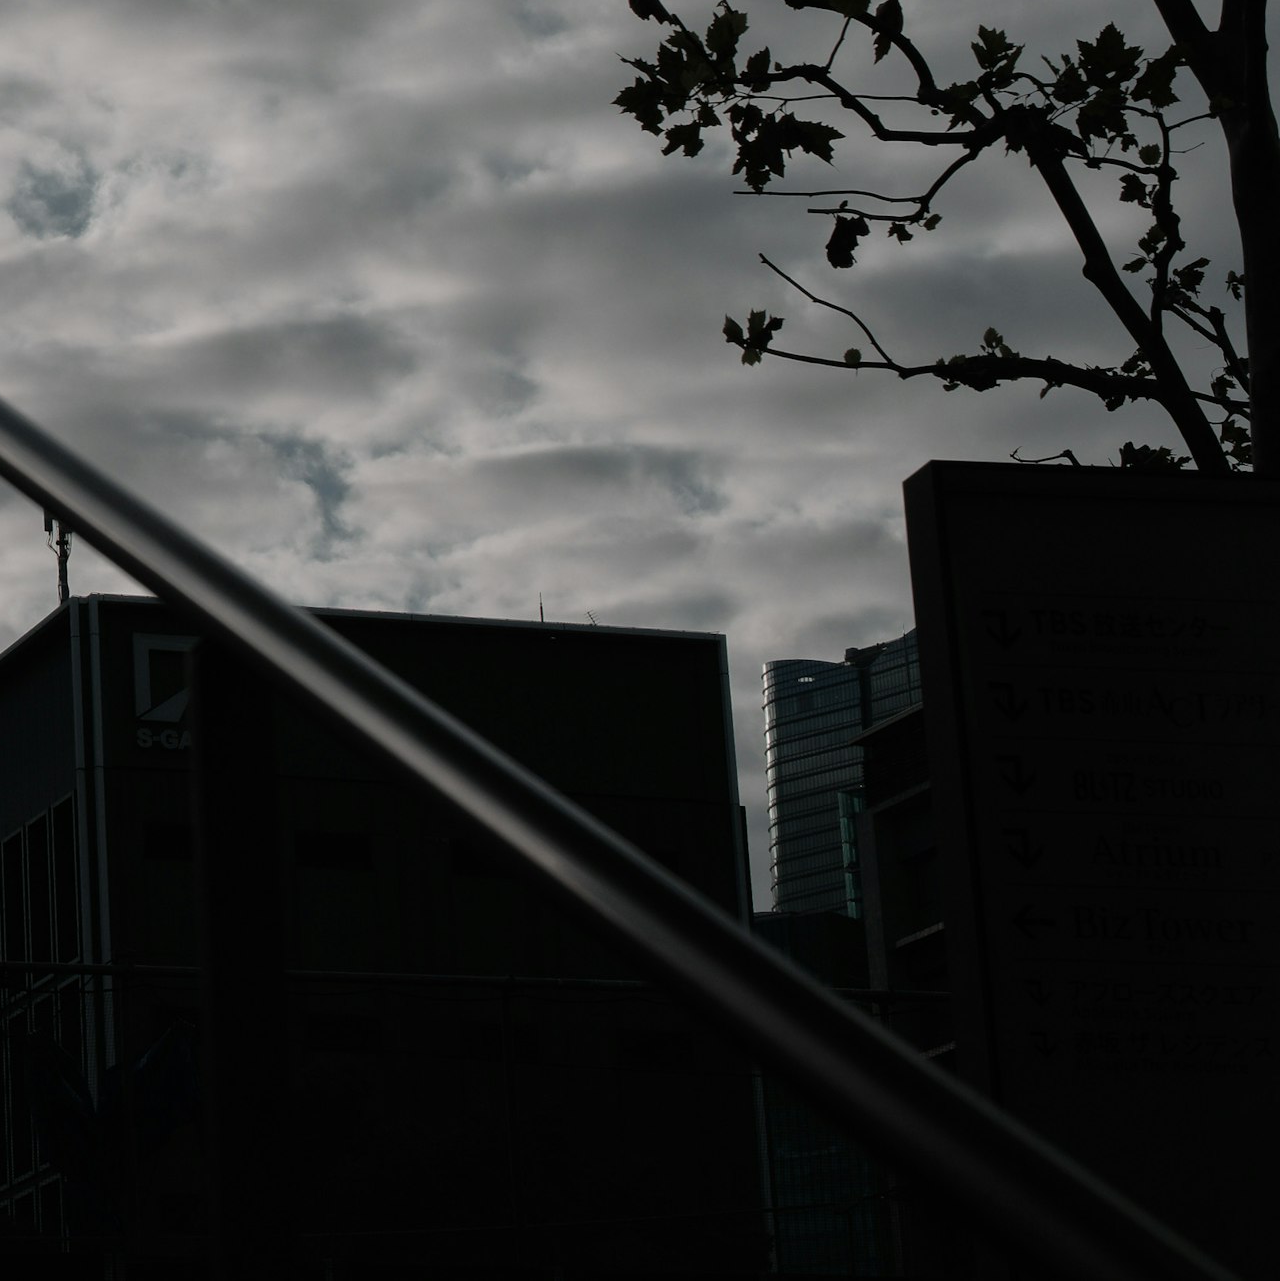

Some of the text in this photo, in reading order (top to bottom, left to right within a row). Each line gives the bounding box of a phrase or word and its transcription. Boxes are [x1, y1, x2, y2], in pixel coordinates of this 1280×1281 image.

[1029, 609, 1231, 639] TBS 放送センター
[1037, 687, 1096, 715] TBS
[1143, 778, 1224, 800] STUDIO
[1091, 834, 1222, 868] Atrium
